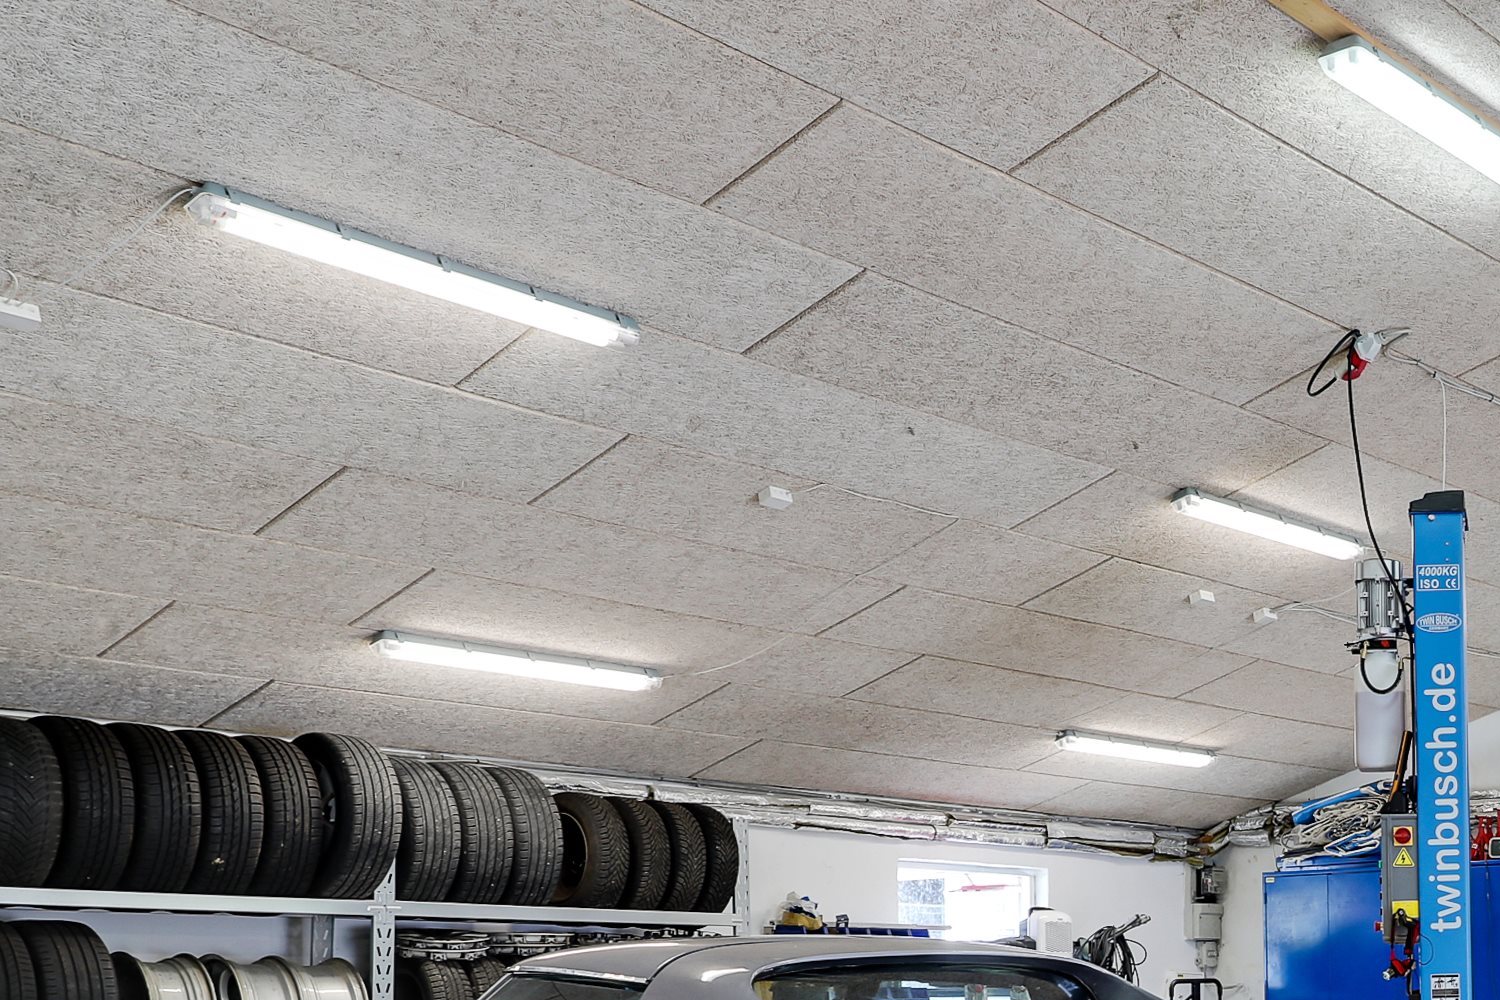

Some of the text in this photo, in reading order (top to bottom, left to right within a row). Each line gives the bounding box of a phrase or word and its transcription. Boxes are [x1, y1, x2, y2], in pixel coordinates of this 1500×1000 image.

[1419, 566, 1457, 576] 4000KG
[1419, 578, 1440, 589] ISO
[1424, 662, 1461, 932] twinbusch.de
